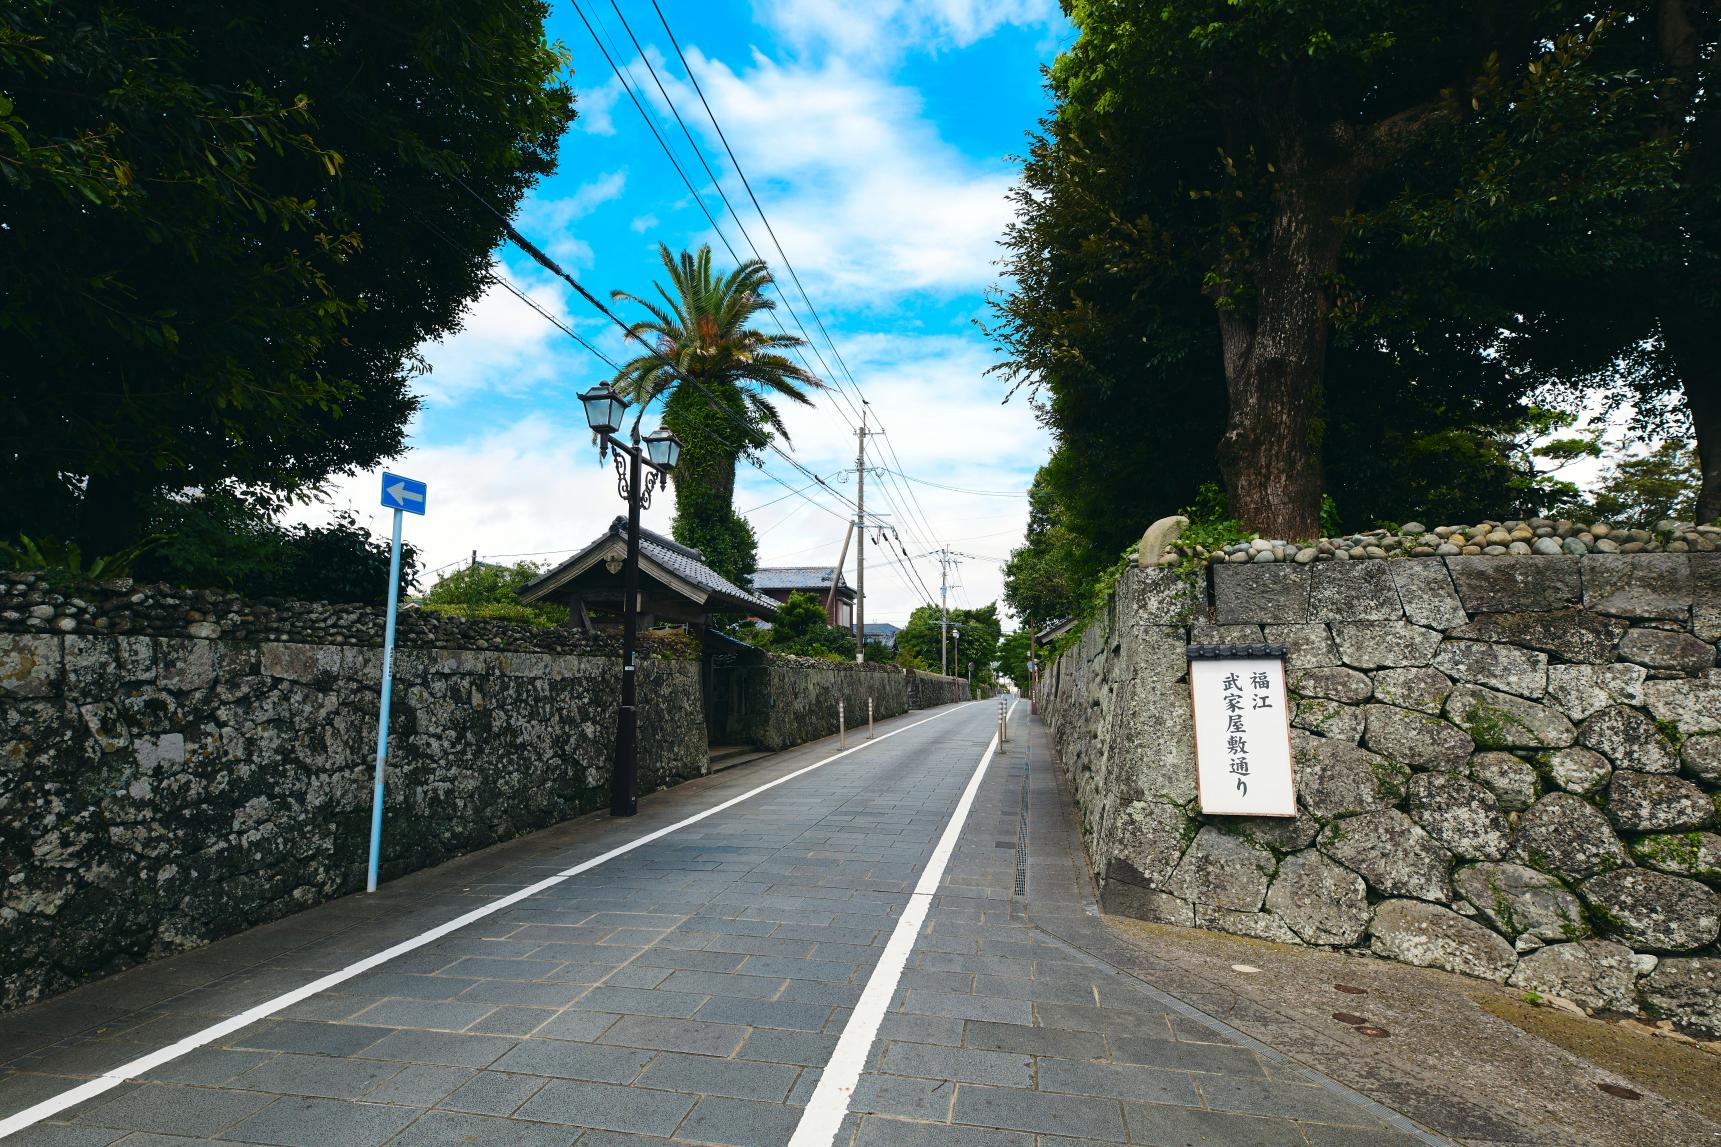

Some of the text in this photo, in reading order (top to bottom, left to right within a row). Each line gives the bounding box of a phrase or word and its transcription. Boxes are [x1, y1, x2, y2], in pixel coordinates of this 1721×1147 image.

[1250, 671, 1273, 711] 福江
[1222, 672, 1251, 798] 武家屋敷通り
